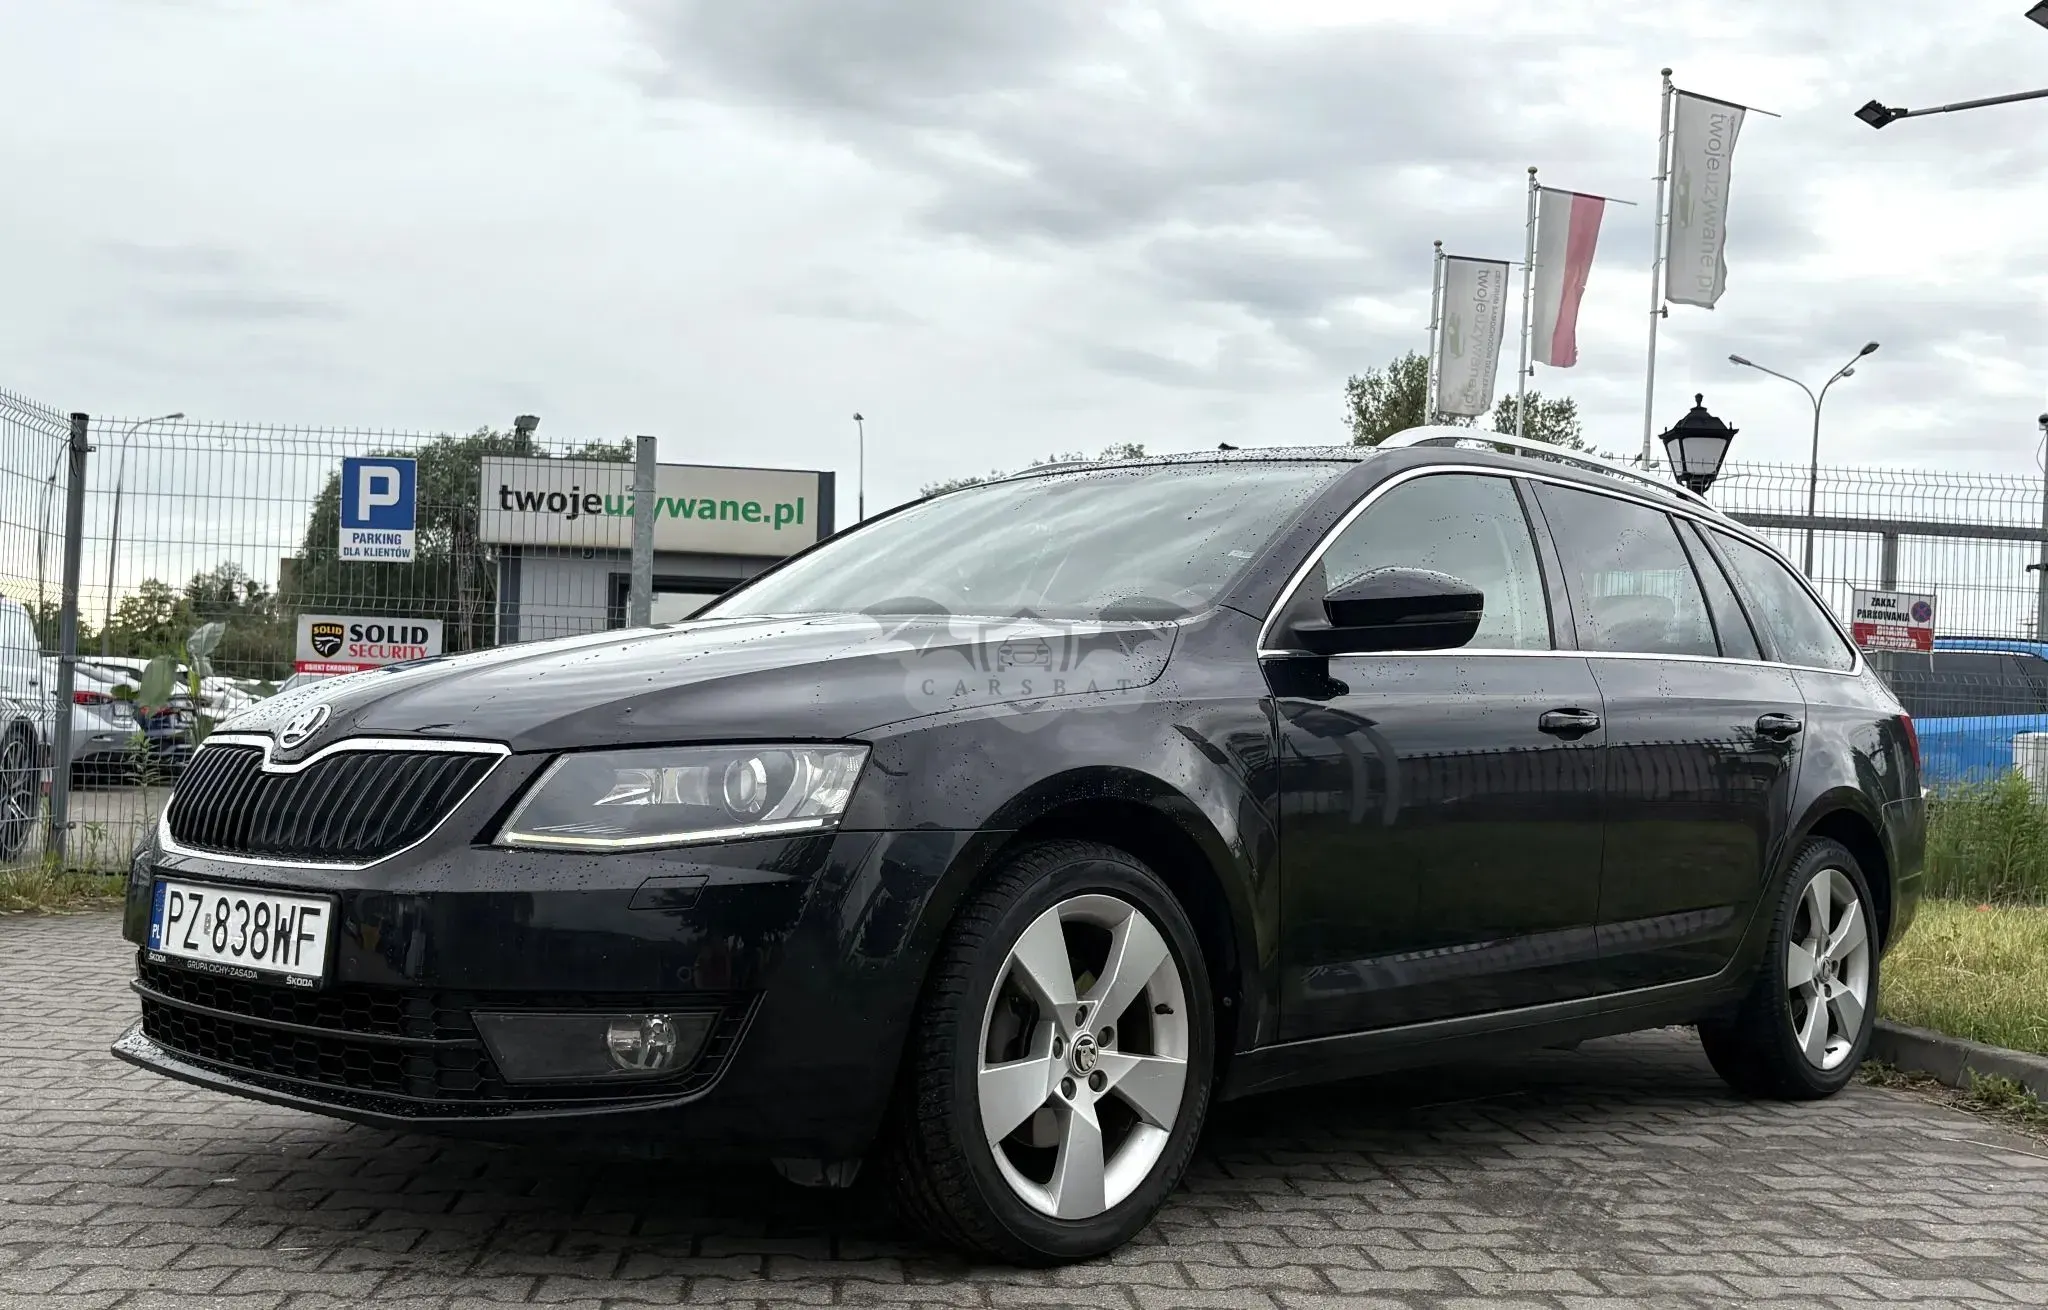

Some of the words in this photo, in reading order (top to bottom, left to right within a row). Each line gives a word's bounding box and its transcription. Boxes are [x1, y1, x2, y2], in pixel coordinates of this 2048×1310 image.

[358, 465, 401, 521] P
[352, 532, 402, 545] PARKING
[343, 547, 361, 557] DLA
[363, 547, 411, 558] KLIENTÓW
[1871, 597, 1896, 608] ZAKAZ
[1856, 609, 1910, 622] PARKOWANIA
[313, 625, 343, 635] SOLID
[349, 624, 429, 645] SOLID
[348, 643, 428, 659] SECURITY
[152, 923, 161, 940] PL
[165, 890, 204, 951] PZ
[212, 896, 322, 967] 838WF
[187, 959, 208, 971] GRUPA
[208, 963, 259, 979] CICHY-ZASADA
[286, 974, 314, 988] ŠKODA
